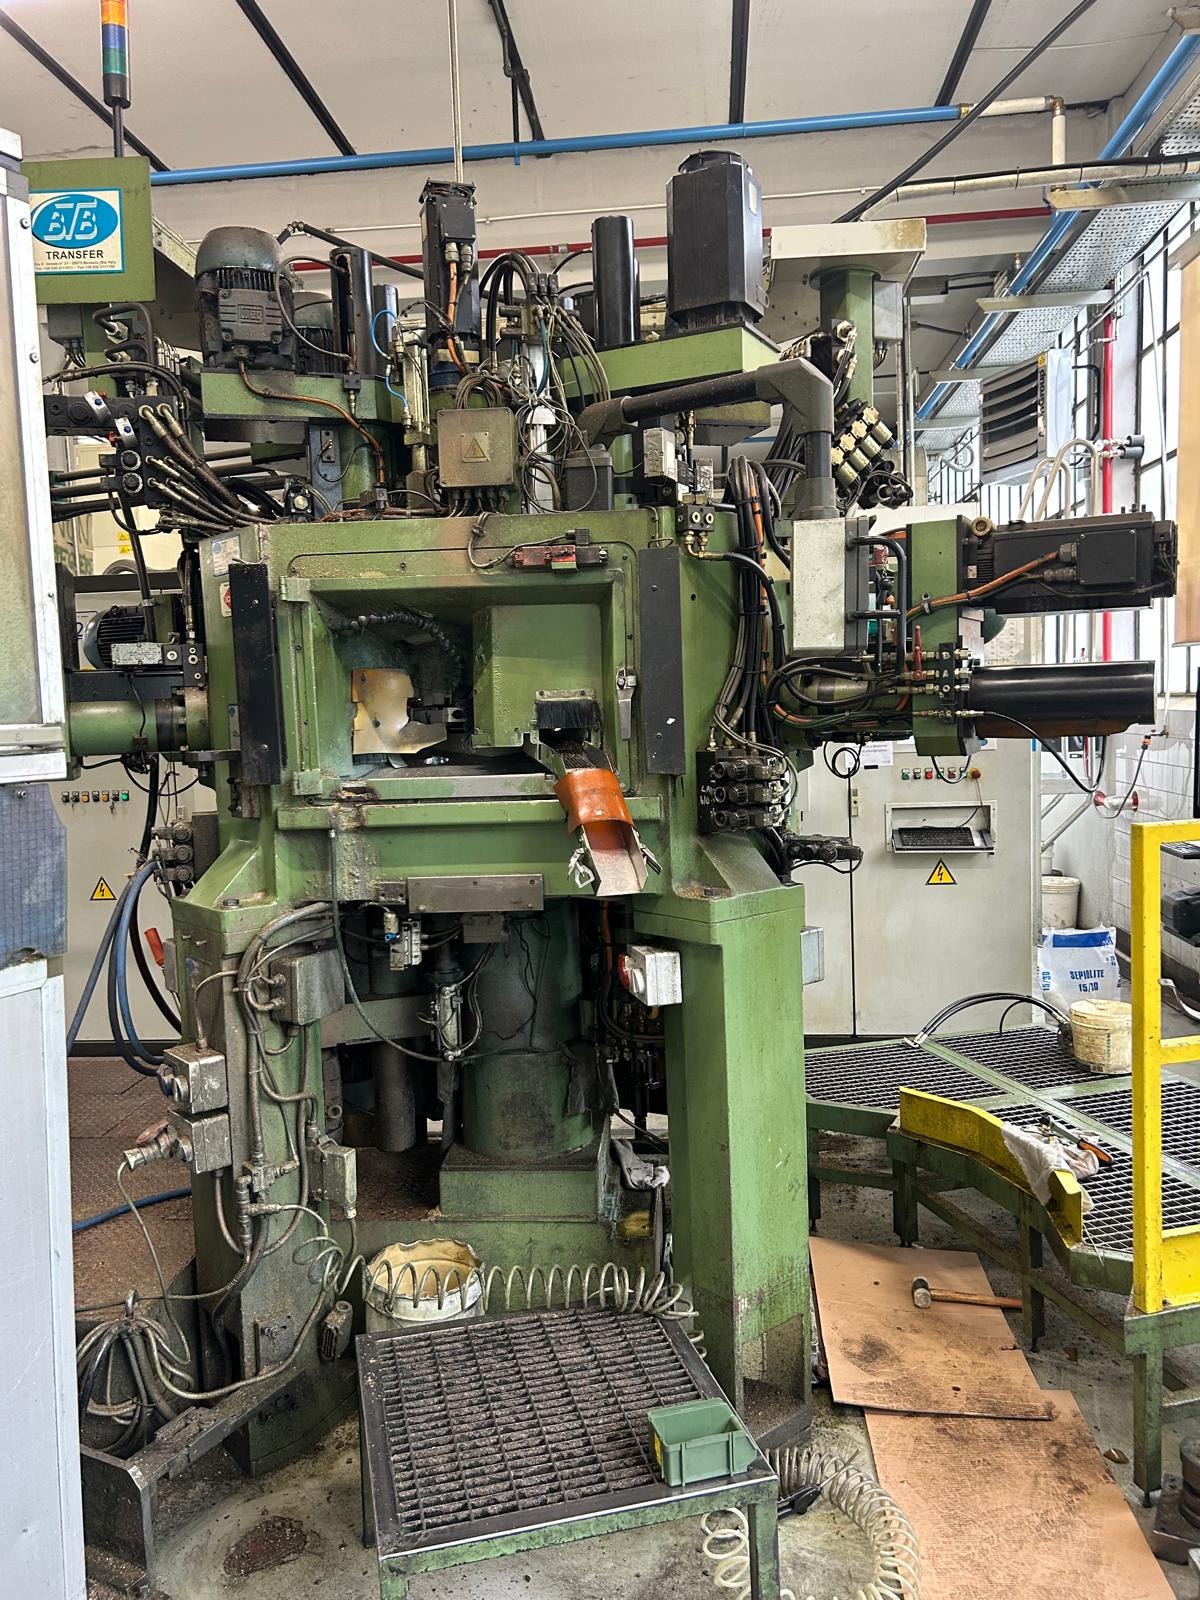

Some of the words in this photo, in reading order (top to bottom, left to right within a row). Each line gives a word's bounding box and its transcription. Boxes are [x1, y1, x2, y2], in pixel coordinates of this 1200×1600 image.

[43, 198, 98, 241] BTB
[45, 249, 104, 260] TRANSFER
[1069, 969, 1105, 980] SEPIOLITE
